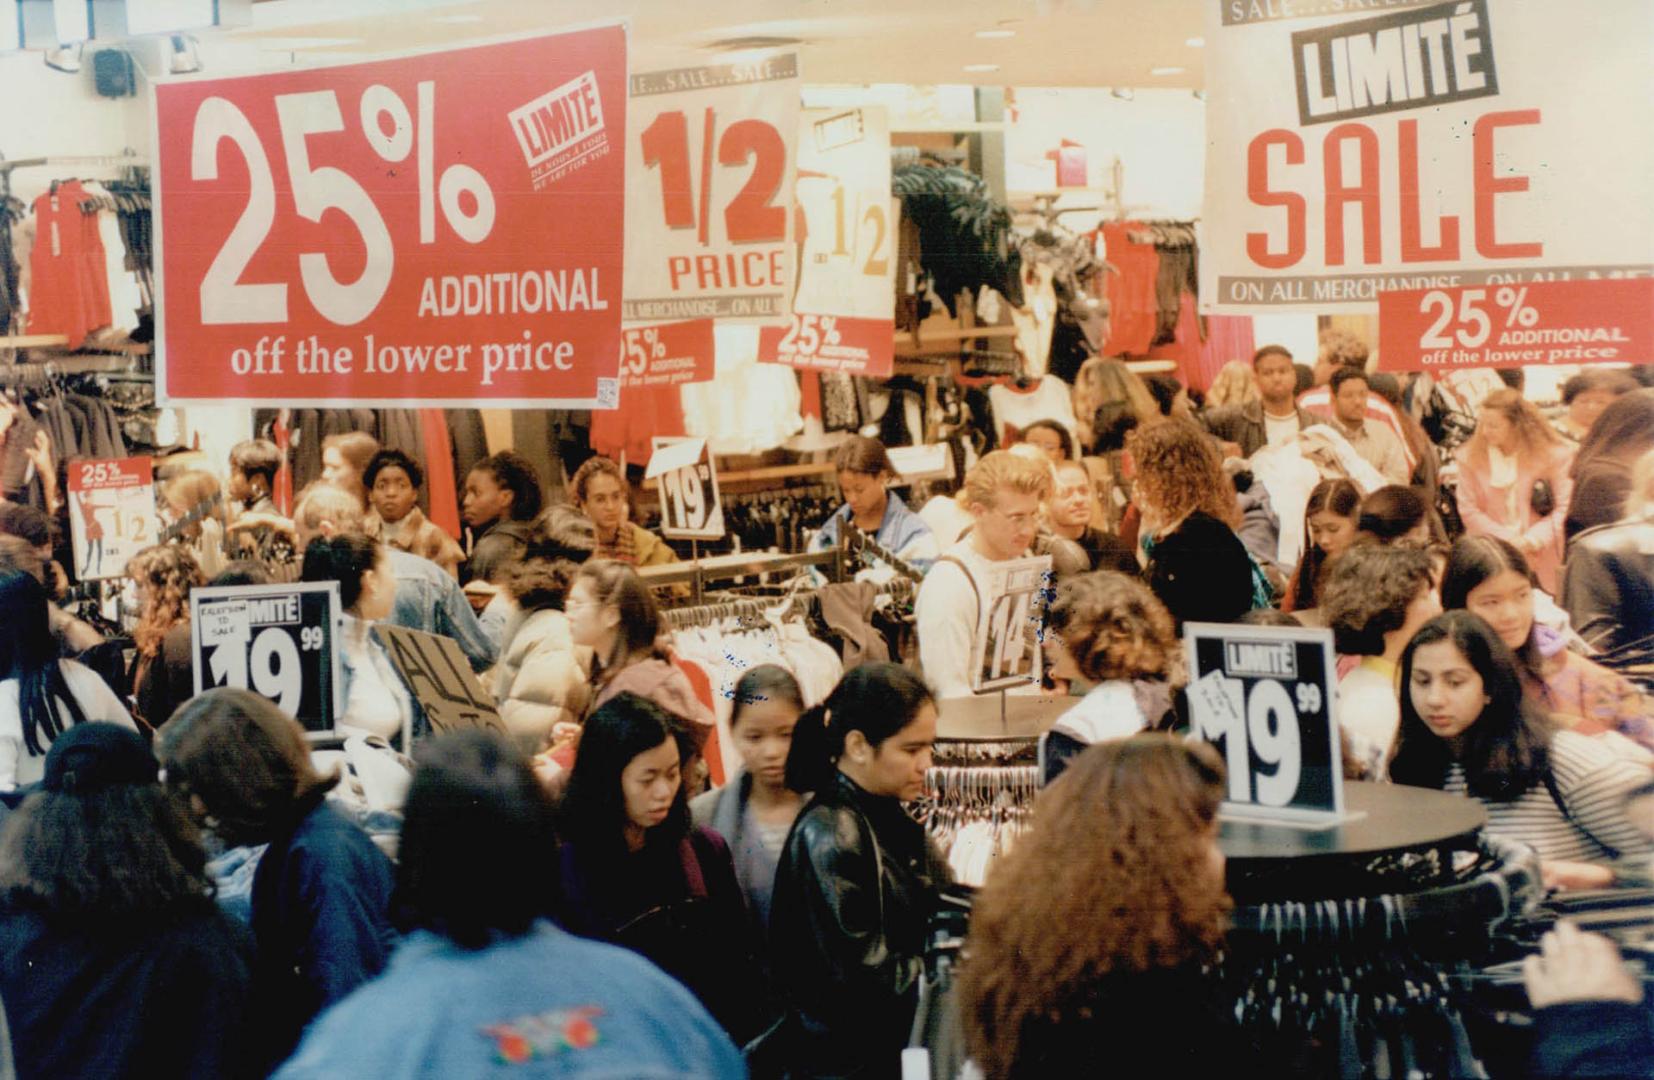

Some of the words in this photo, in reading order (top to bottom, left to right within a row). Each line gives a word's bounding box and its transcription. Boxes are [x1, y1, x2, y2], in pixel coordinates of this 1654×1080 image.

[1303, 4, 1486, 116] LIMITÉ
[517, 78, 598, 158] LIMITÉ
[640, 105, 788, 247] 1/2
[1246, 108, 1543, 270] SALE
[191, 80, 496, 326] 25%
[418, 267, 608, 318] ADDITIONAL
[668, 250, 785, 291] PRICE
[1231, 282, 1264, 301] ON
[1270, 281, 1307, 300] ALL
[778, 314, 841, 356] 25%
[1420, 287, 1540, 349] 25%
[1498, 327, 1631, 347] ADDITIONAL
[231, 336, 286, 375] off
[296, 335, 353, 374] the
[363, 335, 471, 374] lower
[479, 330, 575, 386] price
[1421, 349, 1449, 365] off
[1452, 349, 1480, 364] the
[1485, 348, 1545, 363] lower
[1548, 345, 1620, 364] price
[81, 462, 121, 485] 25%
[664, 465, 706, 530] 19
[300, 626, 324, 652] 99
[1227, 640, 1294, 675] LIMITÉ
[387, 629, 500, 716] ALL
[1295, 681, 1322, 715] 99
